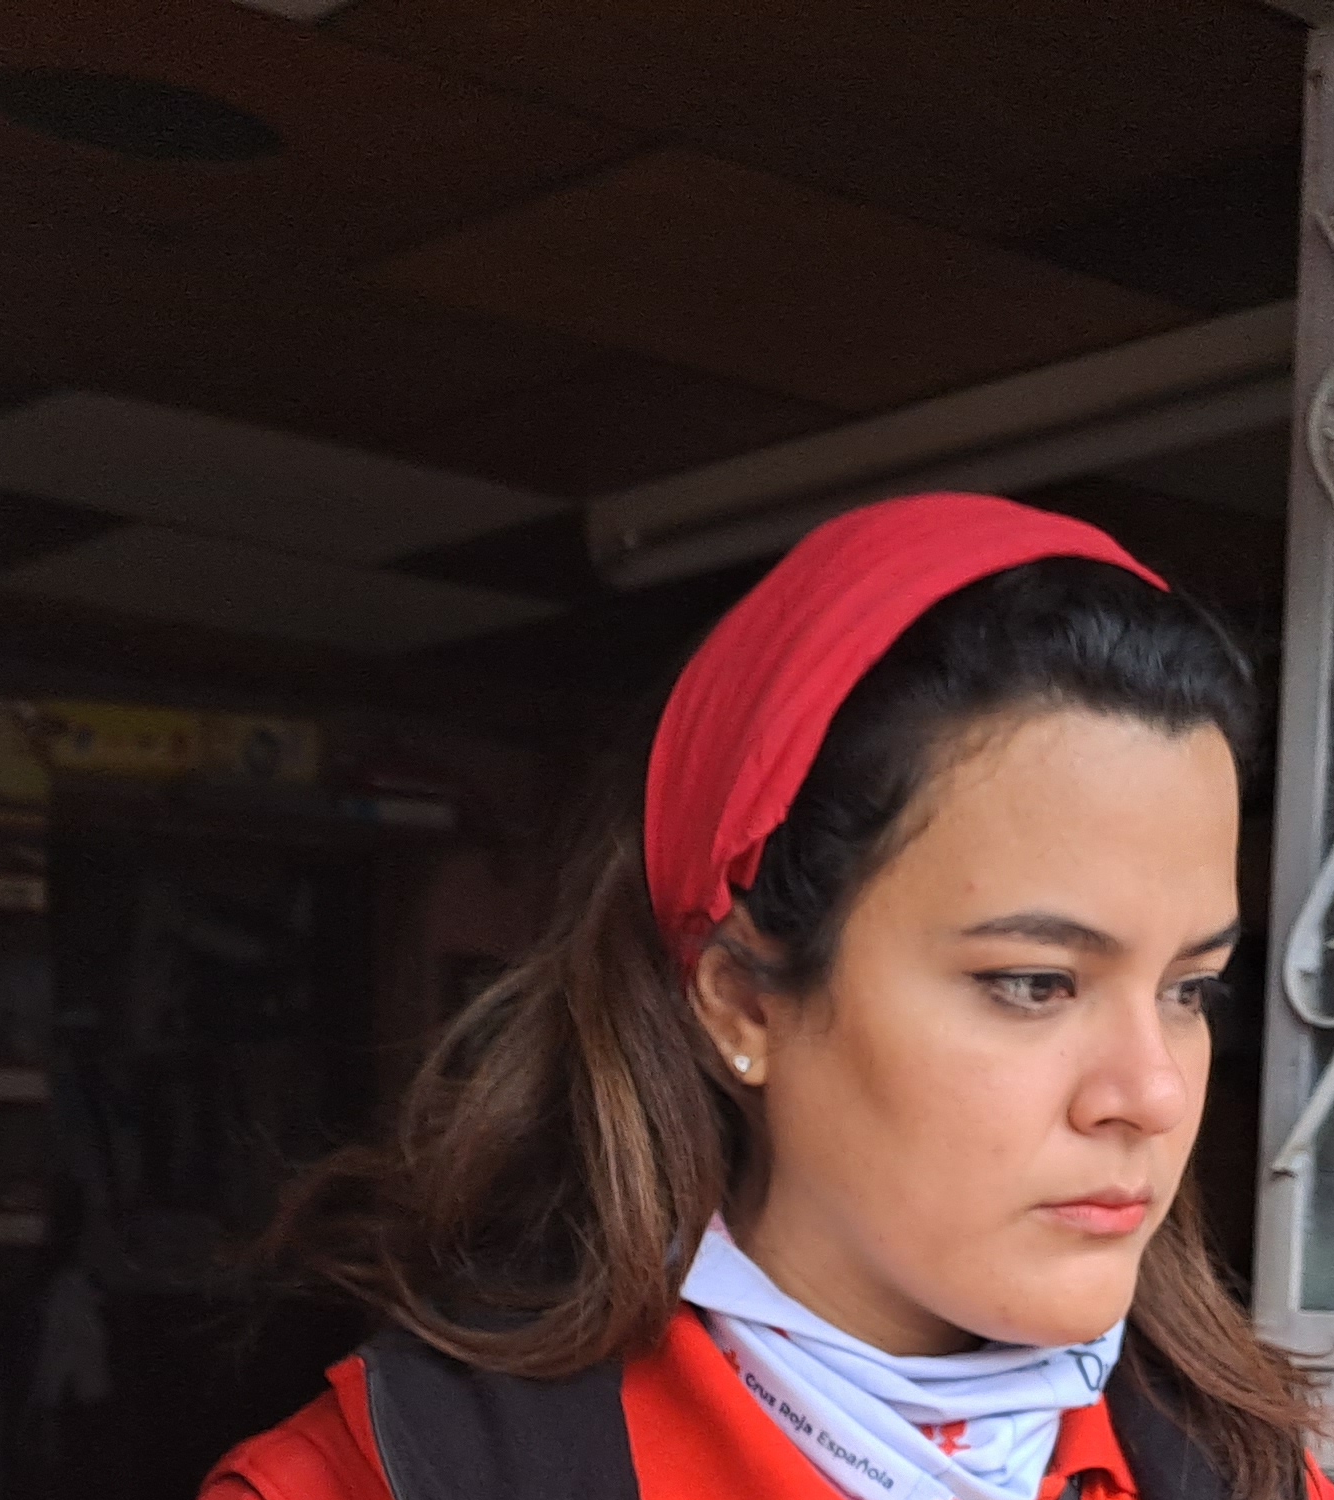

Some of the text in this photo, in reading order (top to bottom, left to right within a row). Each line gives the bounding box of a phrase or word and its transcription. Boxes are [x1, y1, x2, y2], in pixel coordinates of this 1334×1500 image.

[744, 1373, 896, 1491] Cruz Roja Española
